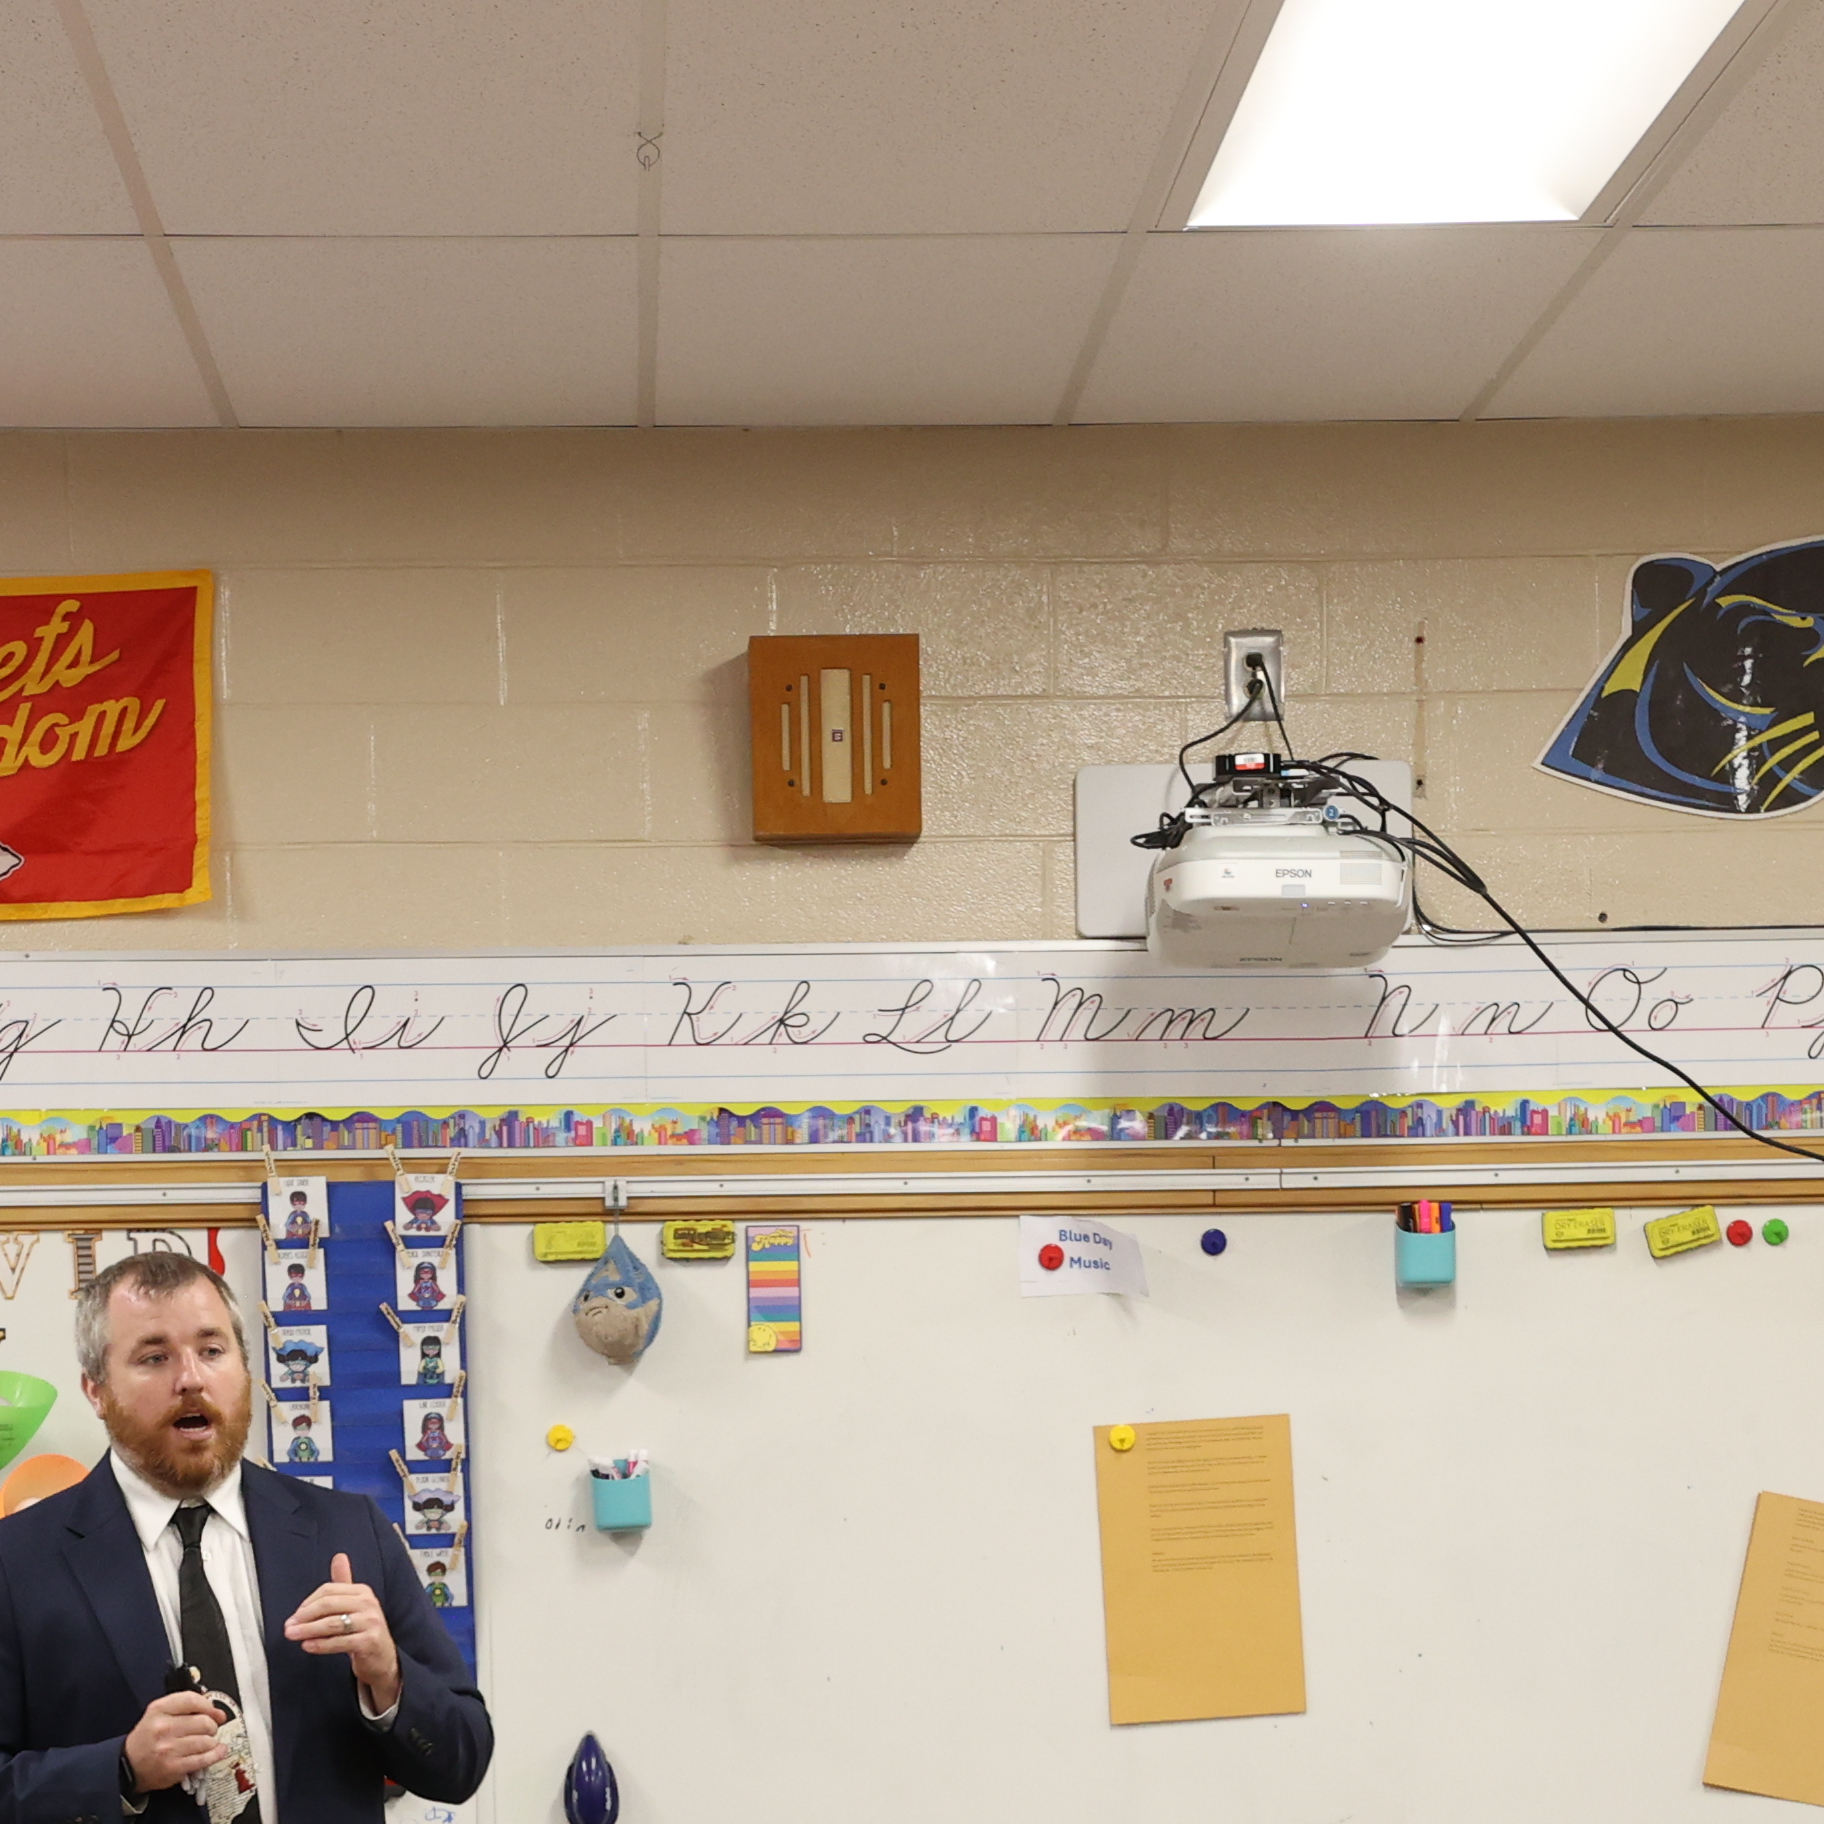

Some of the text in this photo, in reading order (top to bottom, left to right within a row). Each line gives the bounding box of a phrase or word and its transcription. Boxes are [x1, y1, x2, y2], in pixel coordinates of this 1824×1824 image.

[1275, 869, 1312, 878] EPSON
[1058, 1227, 1114, 1252] Blue Day
[1069, 1255, 1111, 1273] Music
